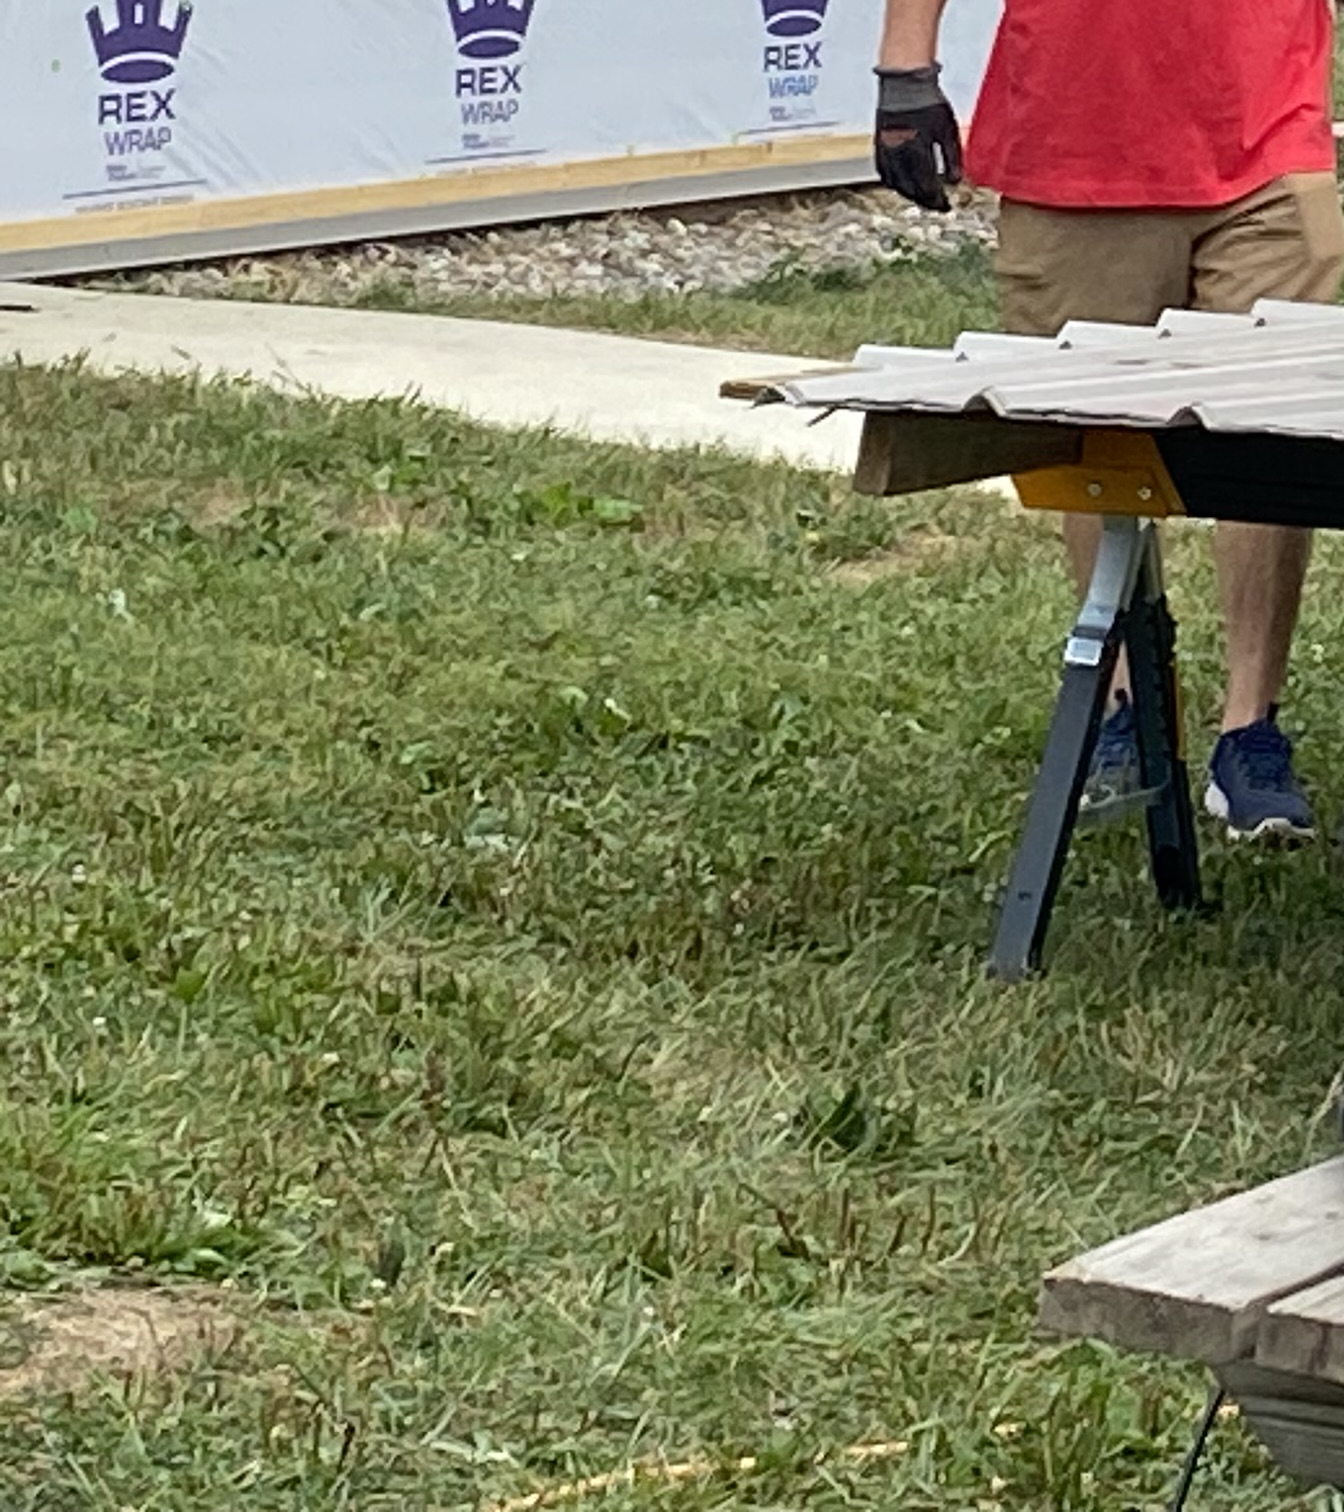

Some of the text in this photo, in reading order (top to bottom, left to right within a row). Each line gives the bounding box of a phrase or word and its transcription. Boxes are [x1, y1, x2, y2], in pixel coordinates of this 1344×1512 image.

[763, 41, 822, 72] REX
[455, 64, 522, 98] REX
[768, 74, 819, 99] WRAP
[98, 88, 177, 125] REX
[460, 98, 519, 125] WRAP
[103, 126, 172, 156] WRAP
